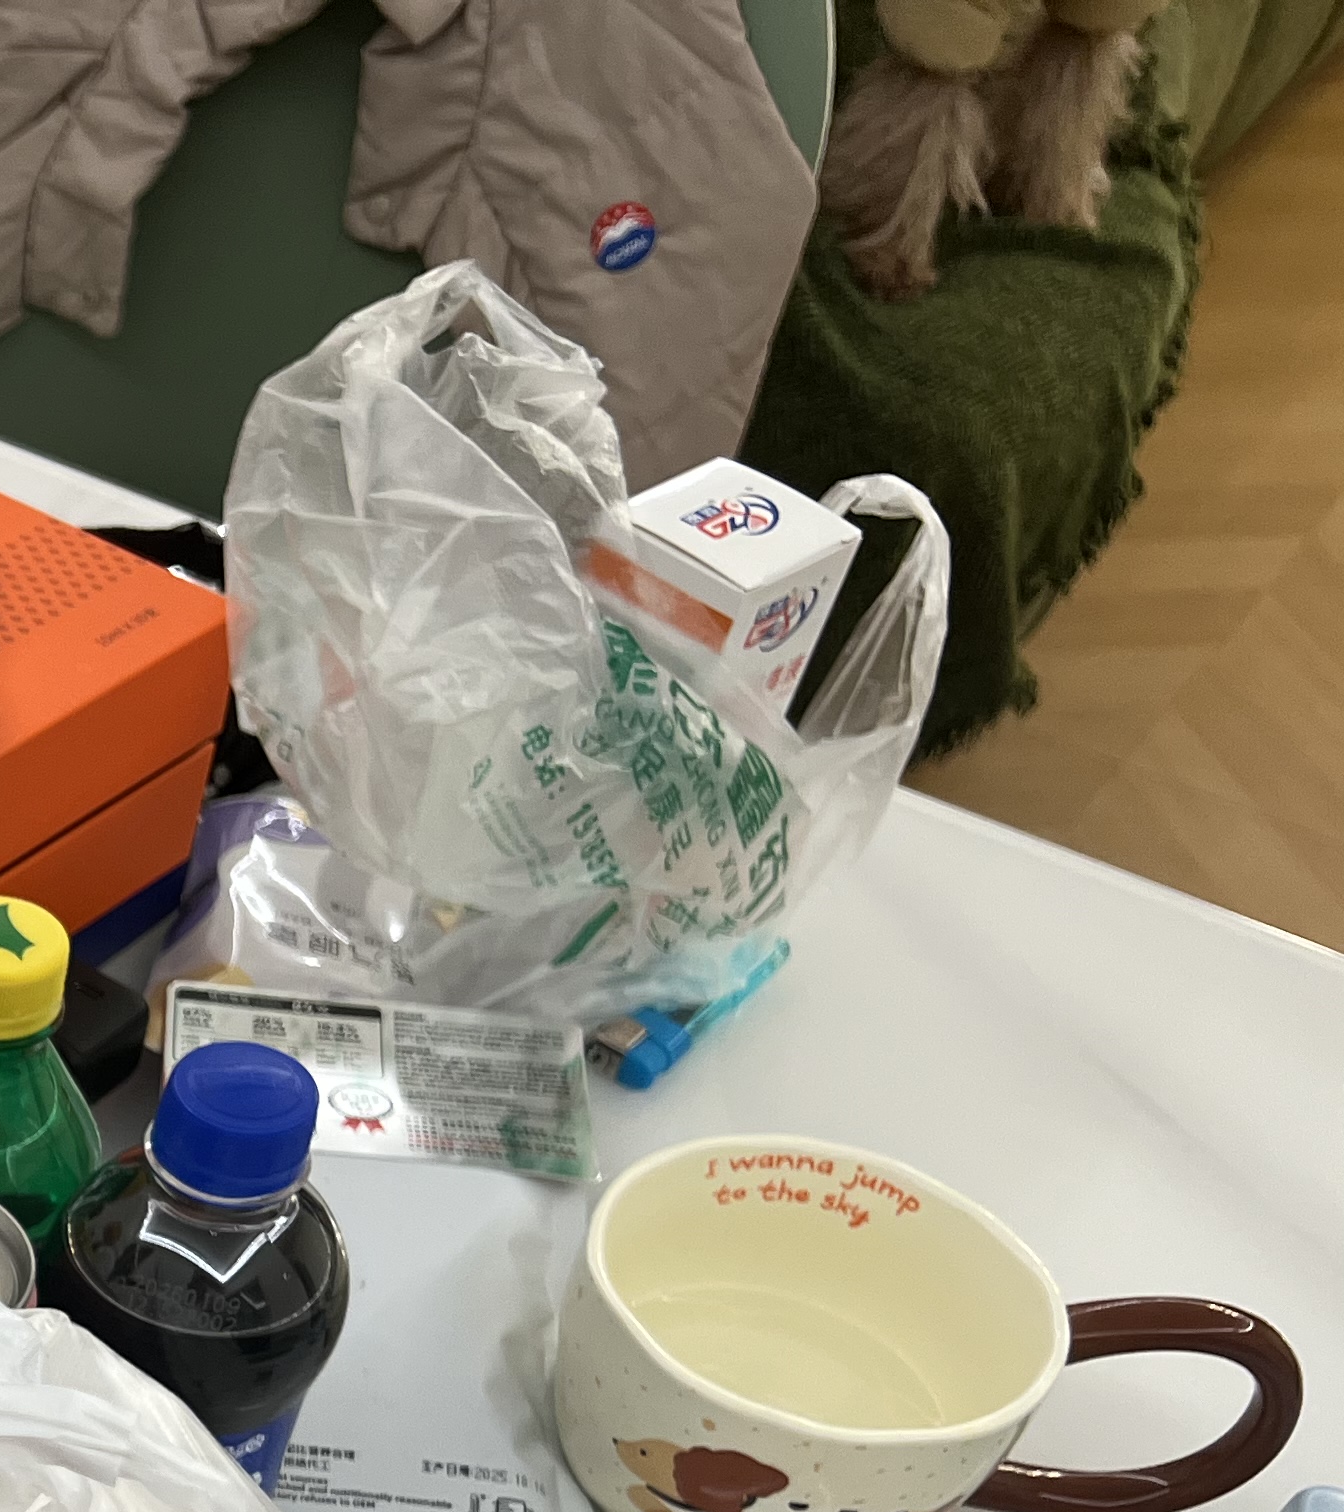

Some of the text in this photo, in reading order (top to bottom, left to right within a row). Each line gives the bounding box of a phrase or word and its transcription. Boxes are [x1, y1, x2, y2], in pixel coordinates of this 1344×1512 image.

[713, 1178, 871, 1229] to the sky
[729, 1154, 834, 1176] wanna
[840, 1164, 922, 1216] jump
